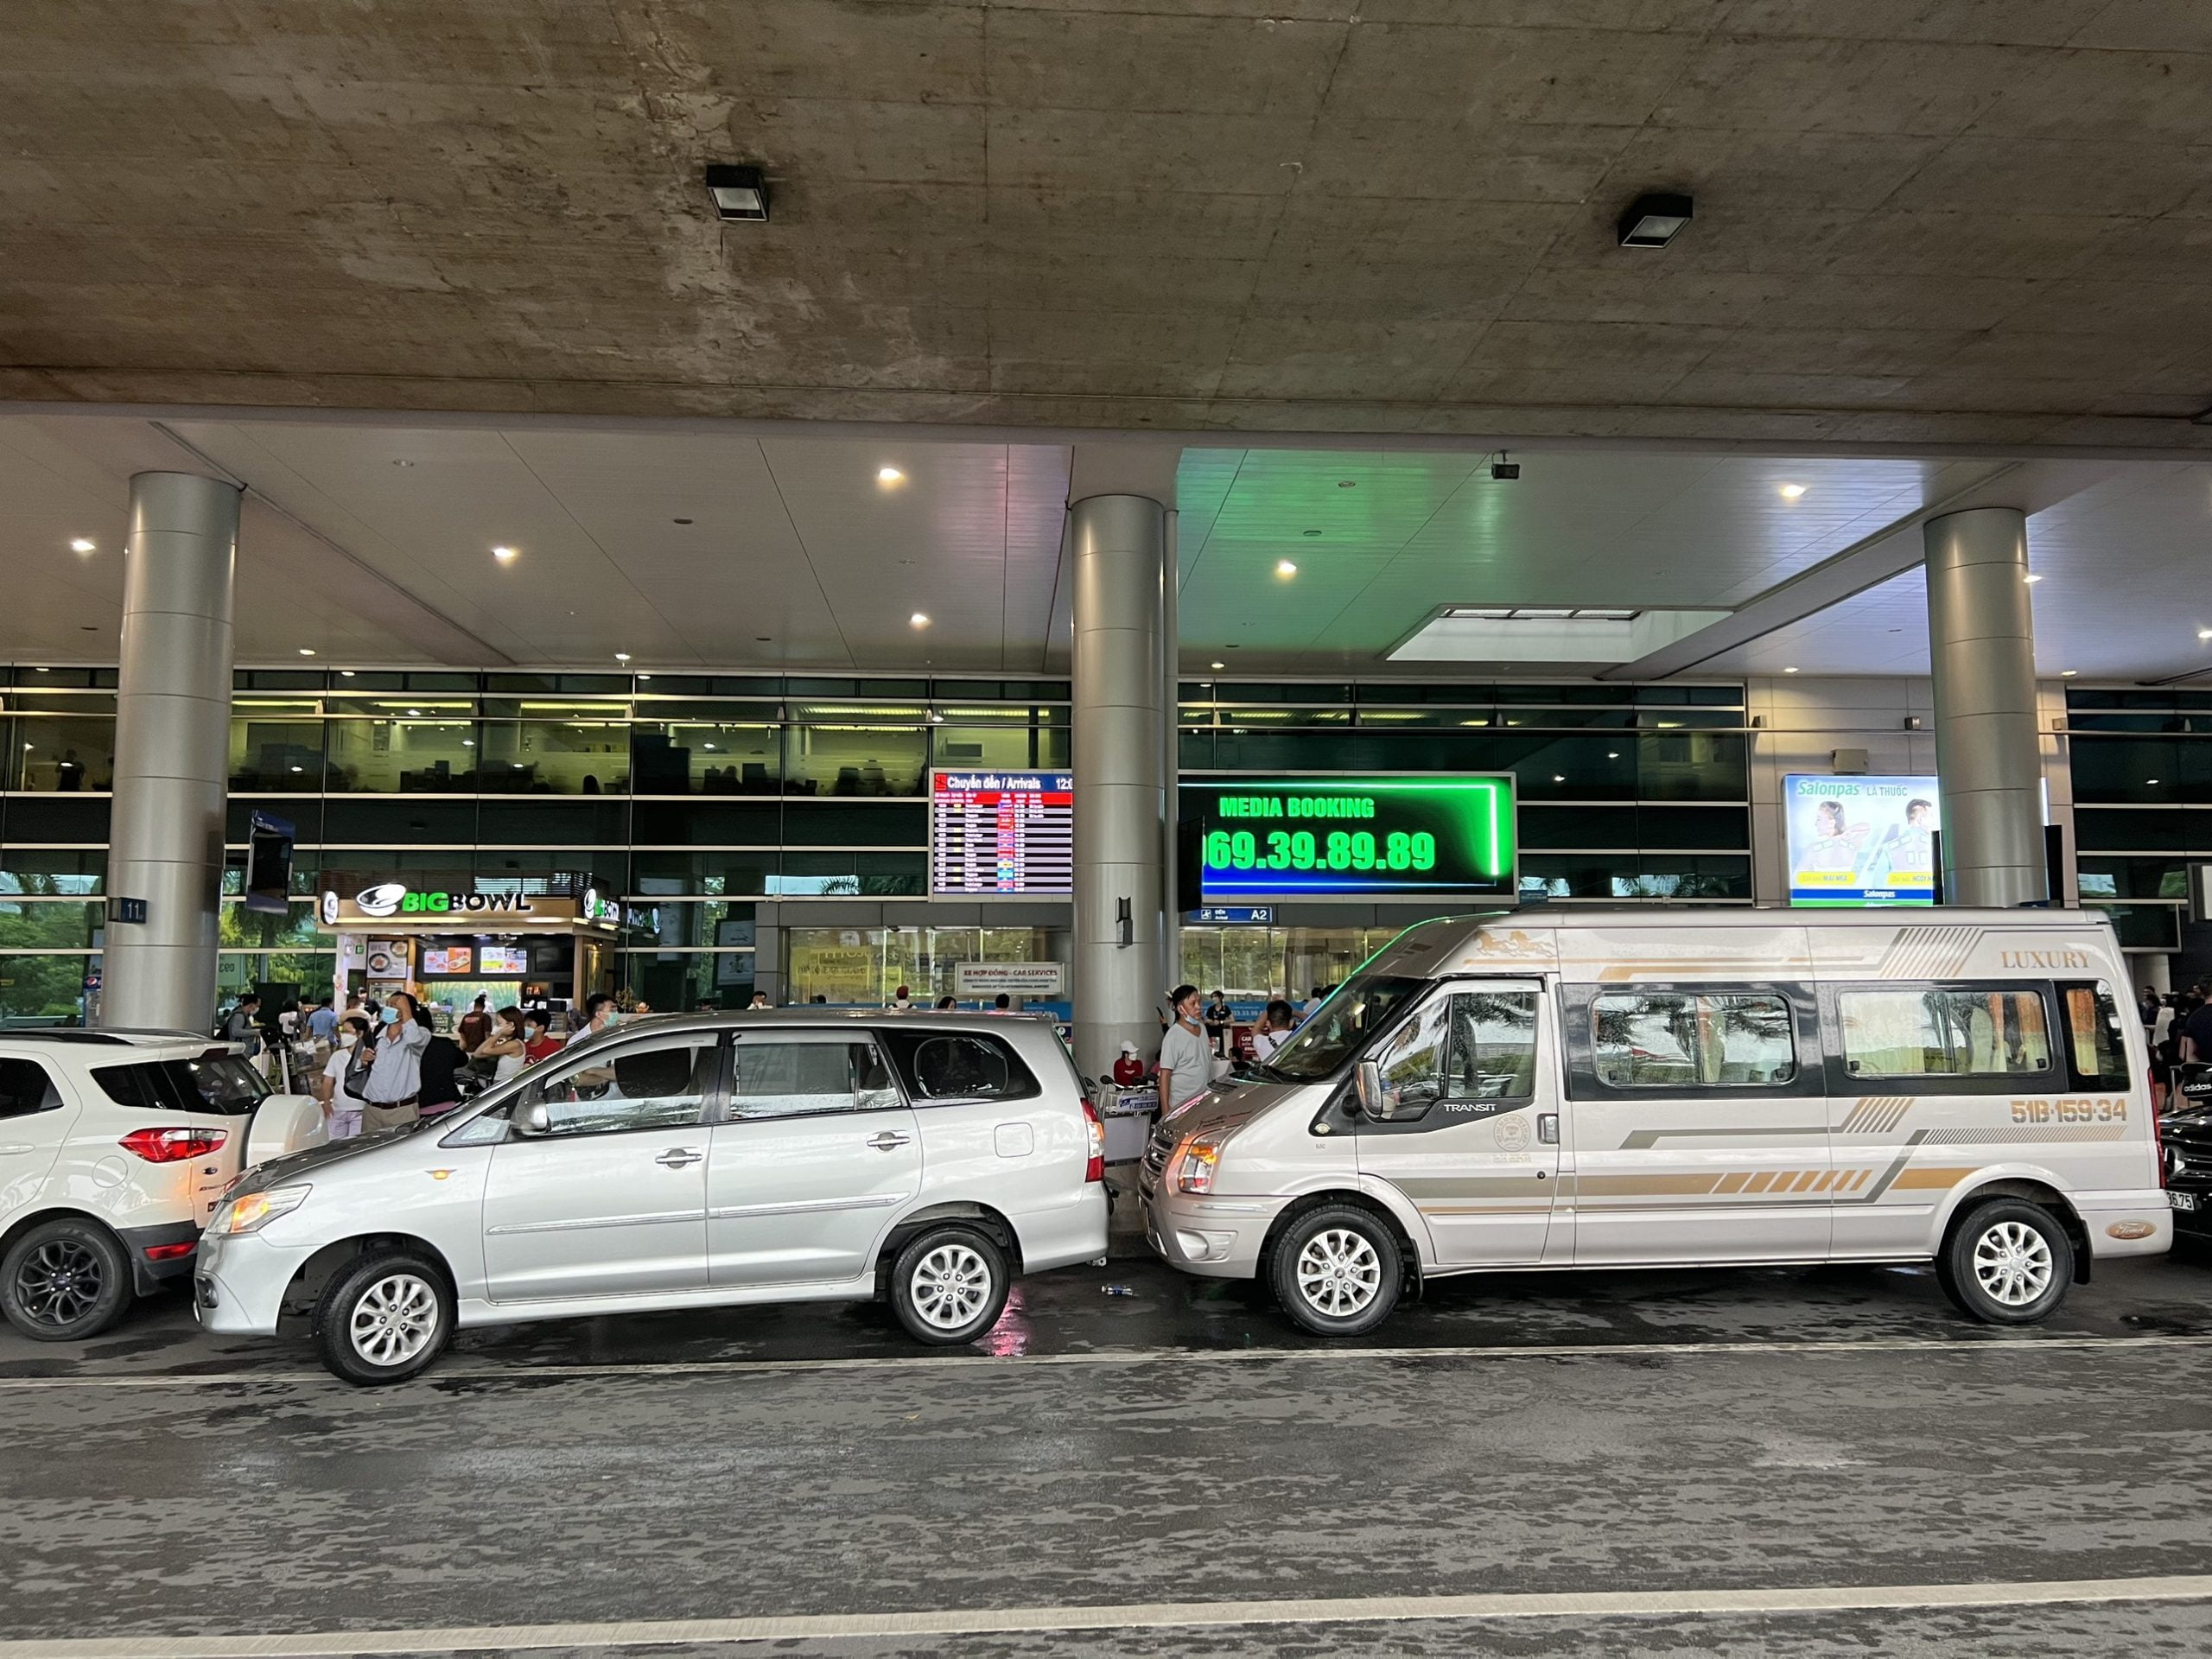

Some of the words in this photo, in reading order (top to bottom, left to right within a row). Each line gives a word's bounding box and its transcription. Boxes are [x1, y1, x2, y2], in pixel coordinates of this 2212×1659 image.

[1007, 777, 1041, 790] Arrivals
[1798, 781, 1860, 798] Salonpas
[1866, 785, 1878, 797] LÀ
[1879, 784, 1908, 797] THUỐC
[1219, 798, 1283, 817] MEDIA
[1287, 798, 1375, 818] BOOKING
[1203, 831, 1435, 869] 69.39.89.89
[1863, 890, 1896, 899] Salonpas
[127, 902, 139, 920] 11
[1251, 909, 1268, 920] A2
[2000, 950, 2090, 969] LUXURY
[2183, 1084, 2212, 1092] adidas
[1444, 1103, 1497, 1112] TRANSIT
[2115, 1223, 2146, 1236] Ford
